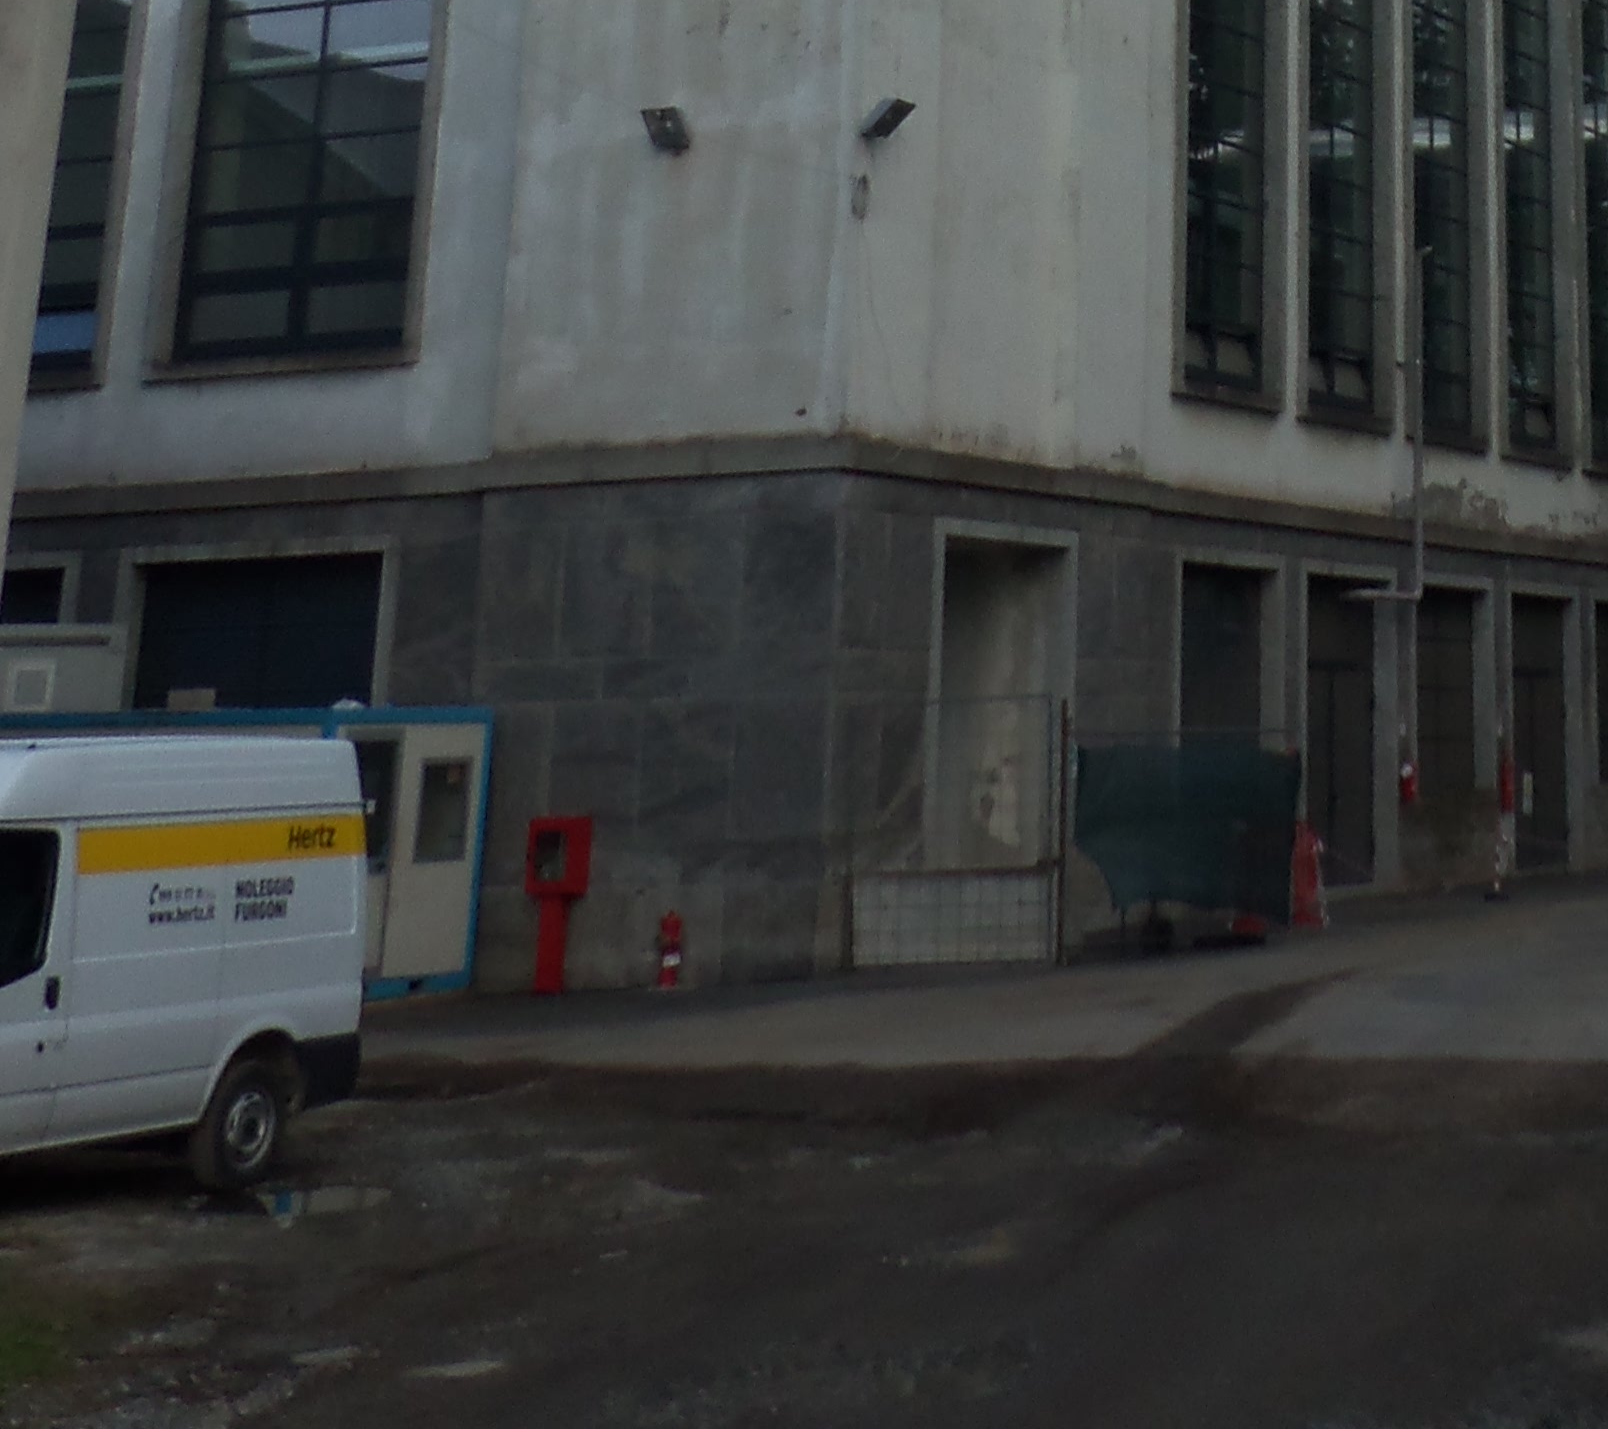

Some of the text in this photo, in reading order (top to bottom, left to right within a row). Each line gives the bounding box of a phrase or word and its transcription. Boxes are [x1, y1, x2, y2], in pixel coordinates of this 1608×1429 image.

[287, 824, 335, 850] Hertz
[235, 877, 294, 898] NOLEGGIO
[235, 898, 288, 921] FURGONI
